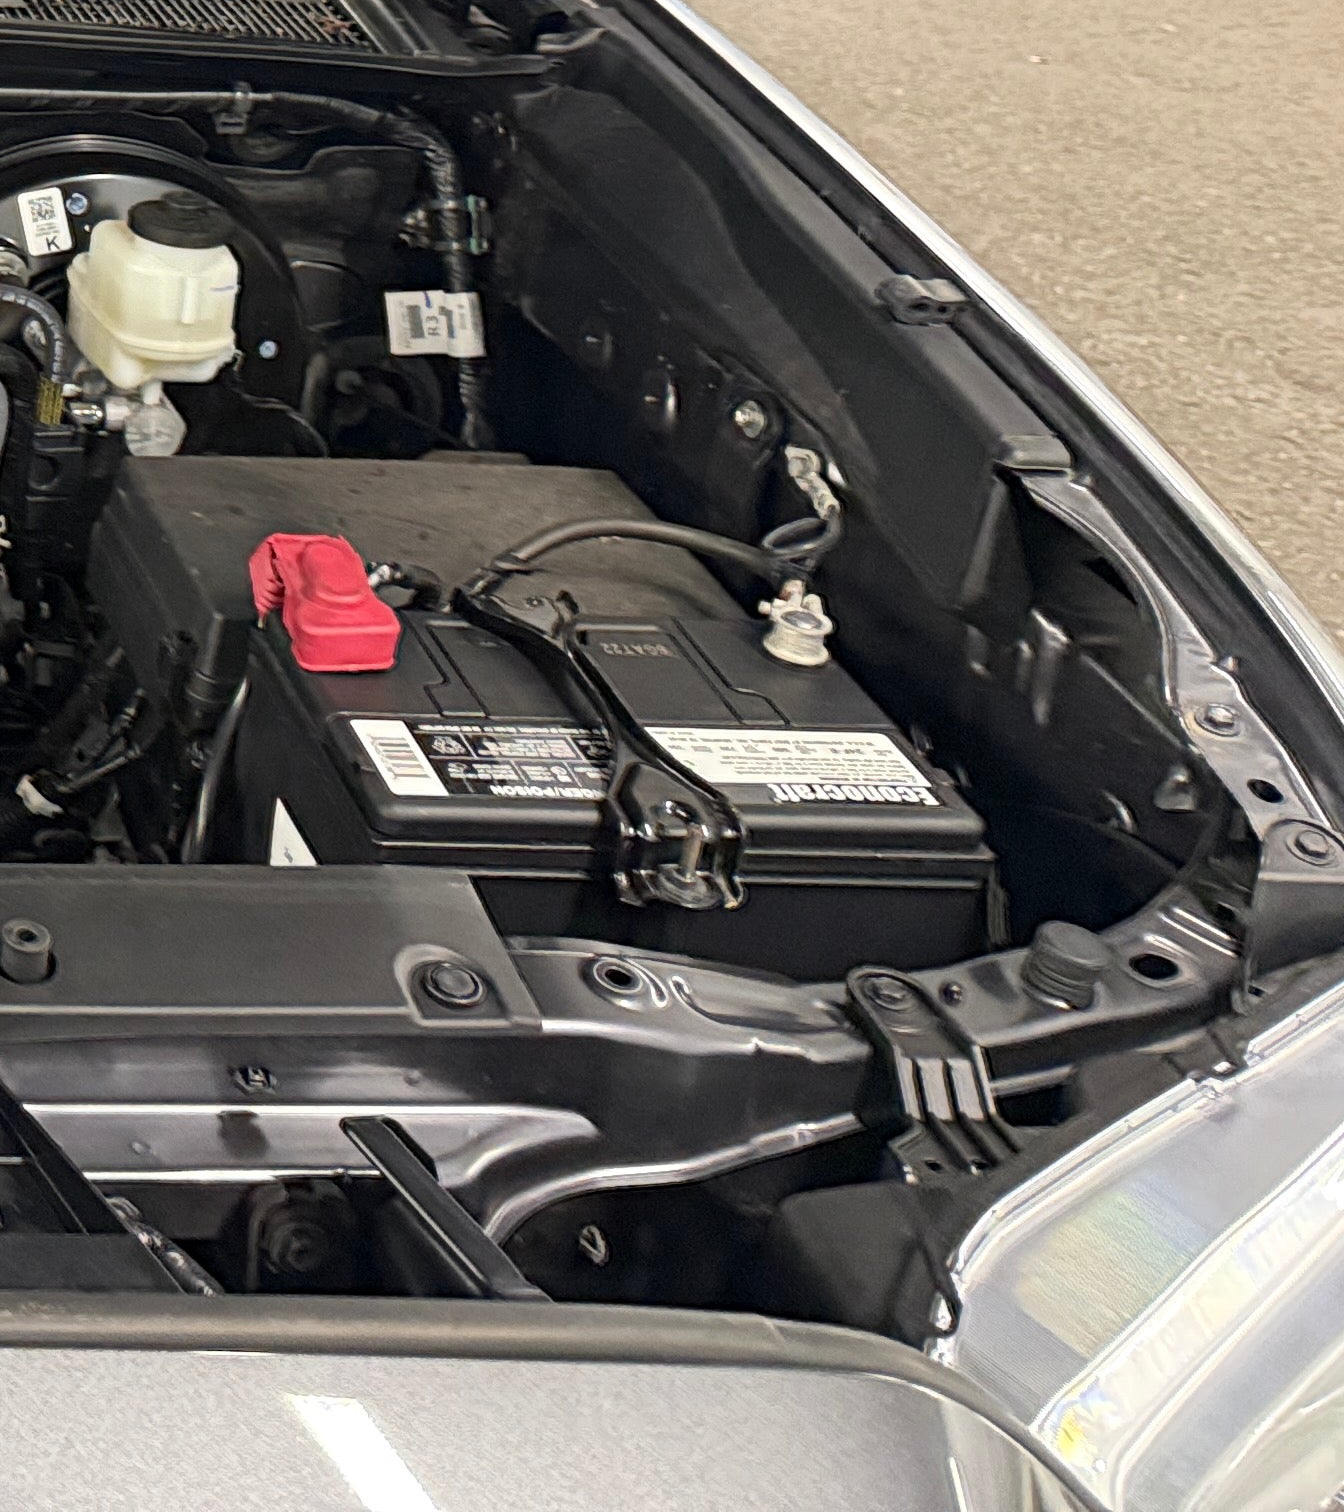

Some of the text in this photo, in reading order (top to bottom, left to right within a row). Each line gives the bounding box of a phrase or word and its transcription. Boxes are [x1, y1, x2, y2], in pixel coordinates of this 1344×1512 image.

[45, 236, 60, 251] K
[490, 783, 607, 800] NGER/POISON
[766, 783, 940, 806] Econocraft
